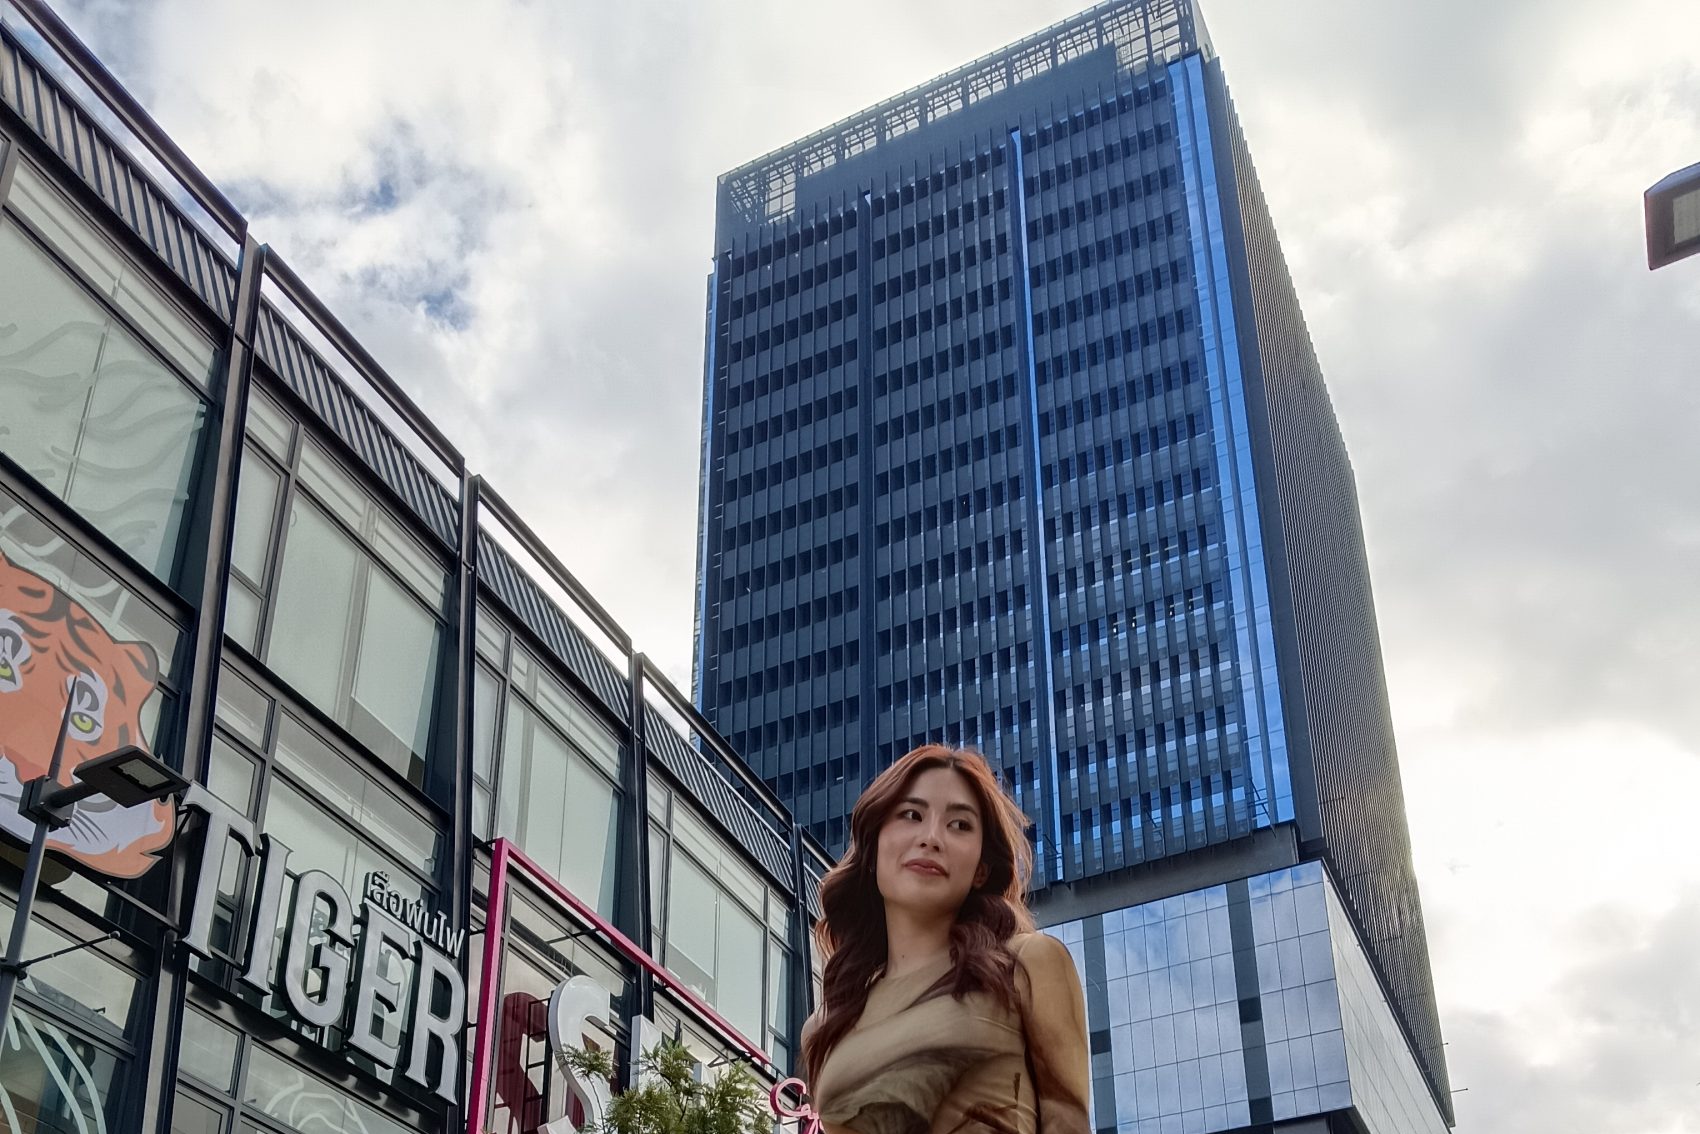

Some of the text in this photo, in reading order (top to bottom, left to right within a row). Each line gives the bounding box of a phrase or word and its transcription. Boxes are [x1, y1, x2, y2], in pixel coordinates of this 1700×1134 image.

[180, 781, 466, 1106] TIGER
[363, 871, 465, 960] เสือพ่นไฟ
